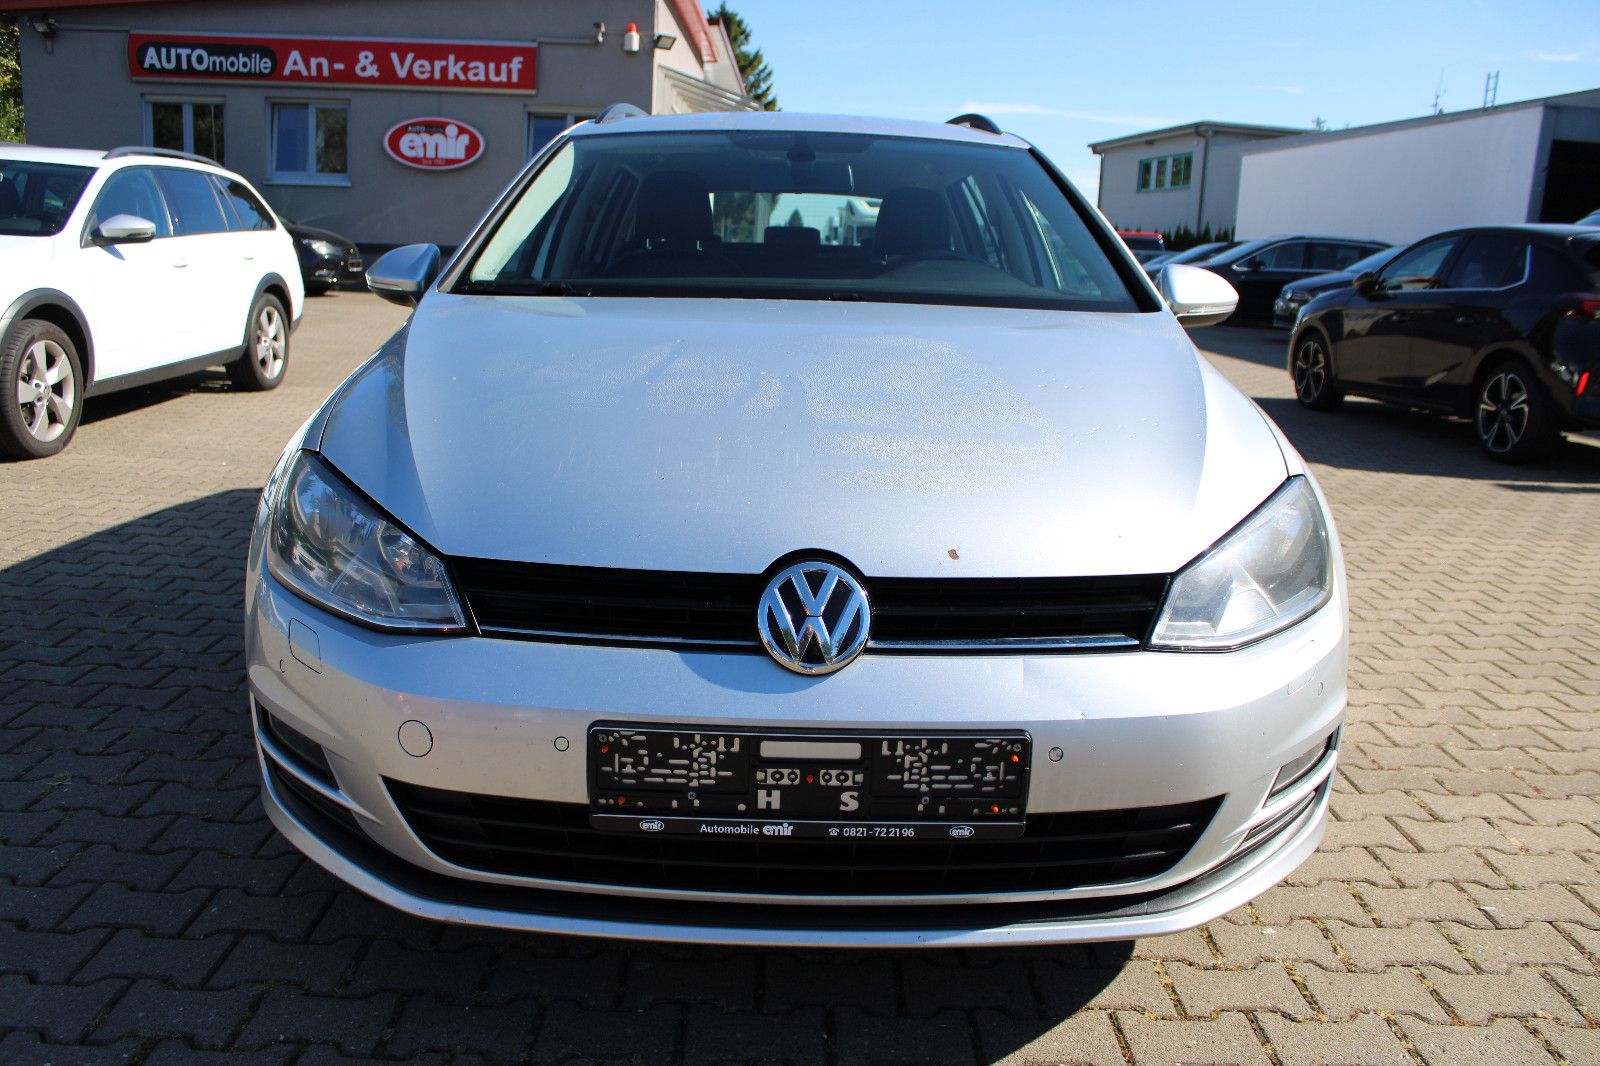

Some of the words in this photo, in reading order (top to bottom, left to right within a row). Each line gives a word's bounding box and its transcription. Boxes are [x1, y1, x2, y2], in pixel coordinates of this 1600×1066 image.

[143, 46, 272, 74] AUTOmobile
[282, 49, 345, 78] An-
[354, 50, 381, 78] &
[390, 51, 525, 84] Verkauf
[399, 123, 470, 160] emir
[700, 823, 760, 835] Automobile
[762, 822, 794, 836] emir
